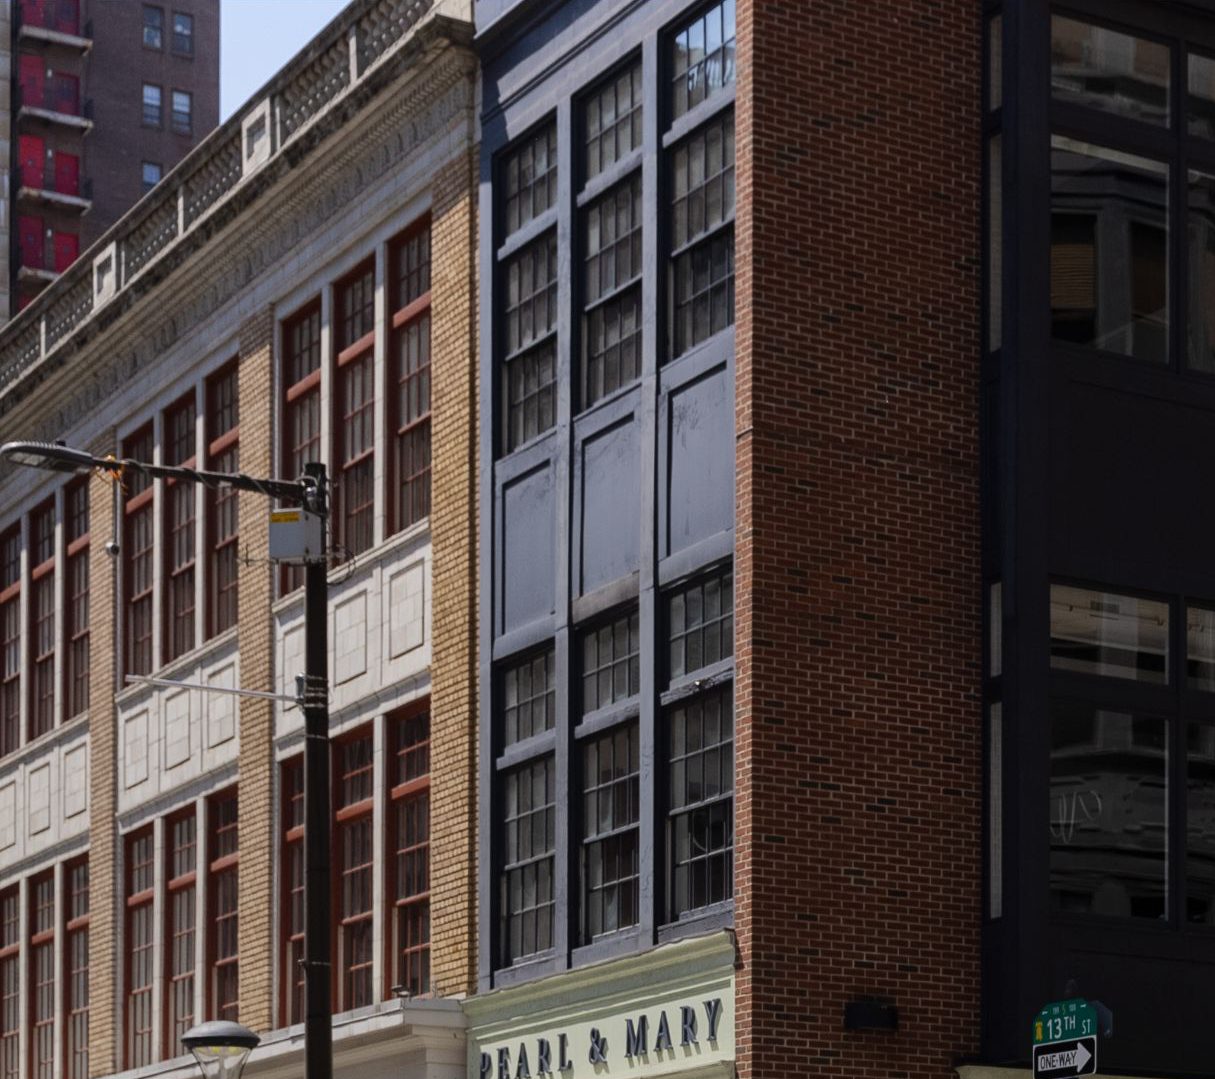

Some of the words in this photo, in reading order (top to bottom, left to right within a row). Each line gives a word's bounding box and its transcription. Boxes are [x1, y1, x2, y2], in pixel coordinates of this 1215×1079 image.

[588, 1027, 608, 1065] &
[624, 998, 723, 1058] MARY
[1047, 1015, 1076, 1040] 13TH
[1081, 1018, 1091, 1035] ST
[1040, 1055, 1057, 1070] ONE
[1058, 1051, 1077, 1067] WAY
